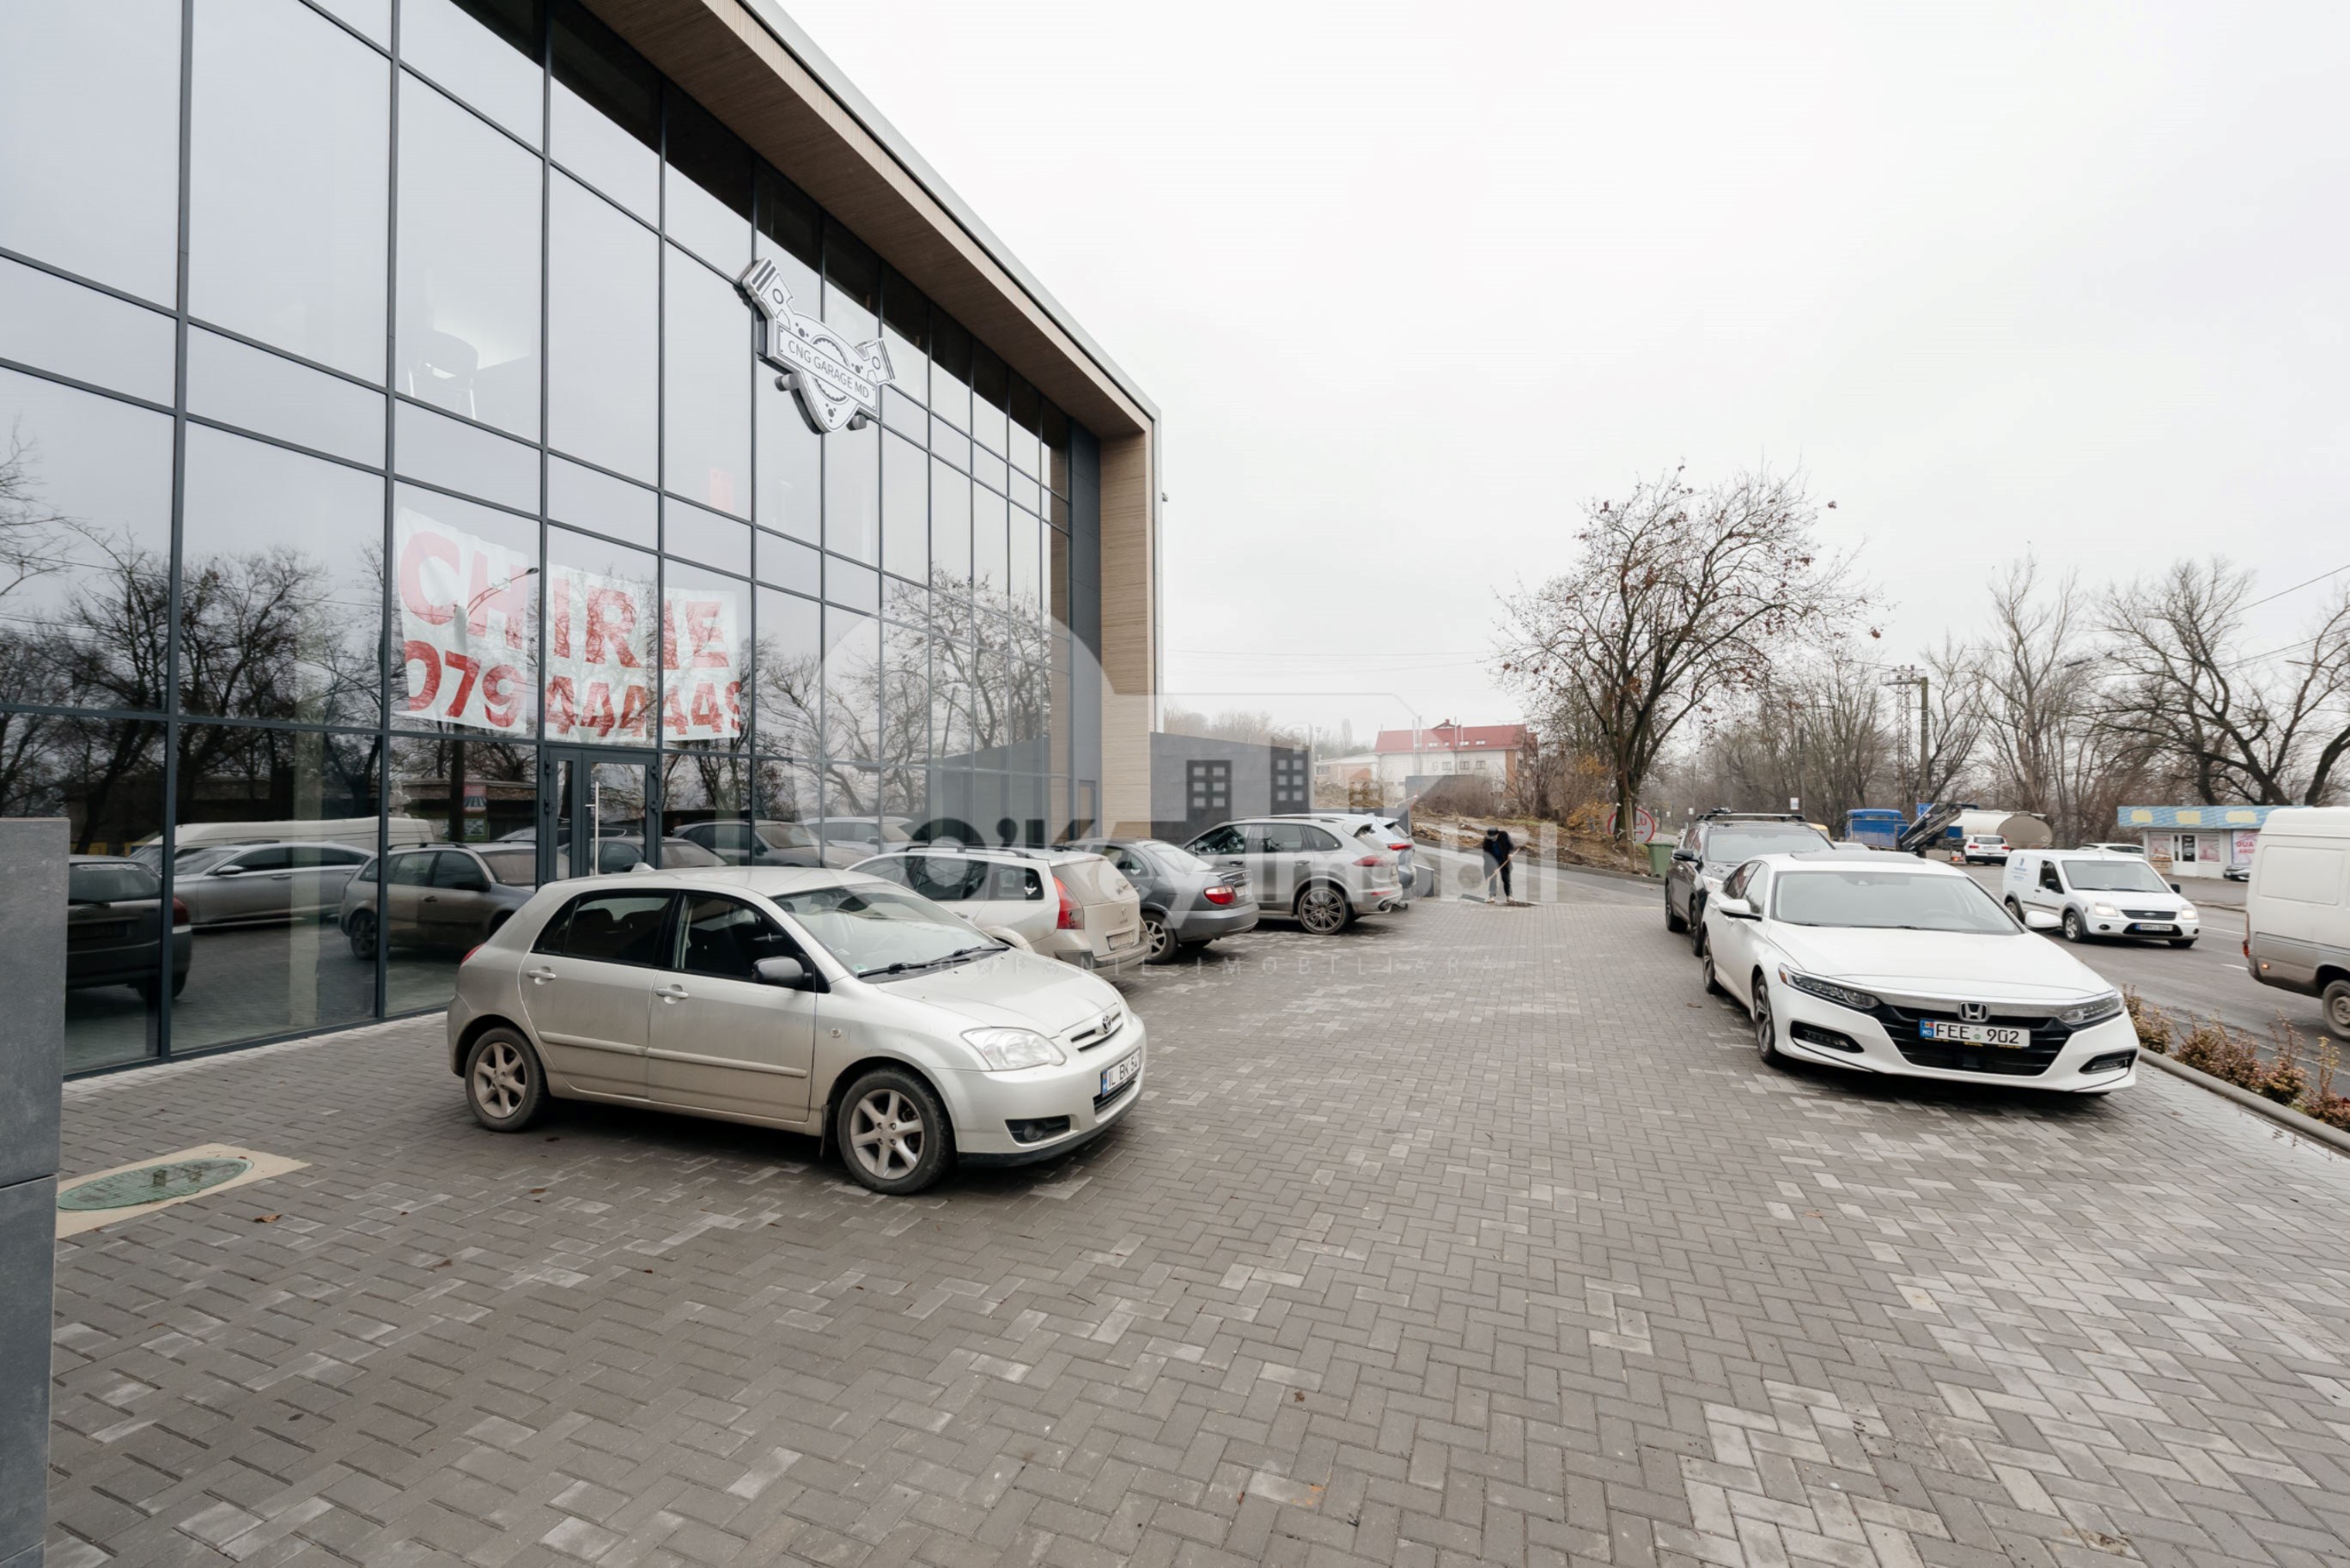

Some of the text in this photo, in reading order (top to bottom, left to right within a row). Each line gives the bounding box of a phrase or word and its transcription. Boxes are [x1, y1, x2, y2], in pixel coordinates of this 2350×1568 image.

[788, 340, 869, 398] CNG GARAGE MD
[399, 530, 730, 670] CHIRIE
[1936, 1024, 1971, 1040] FEE
[1987, 1029, 2019, 1044] 902
